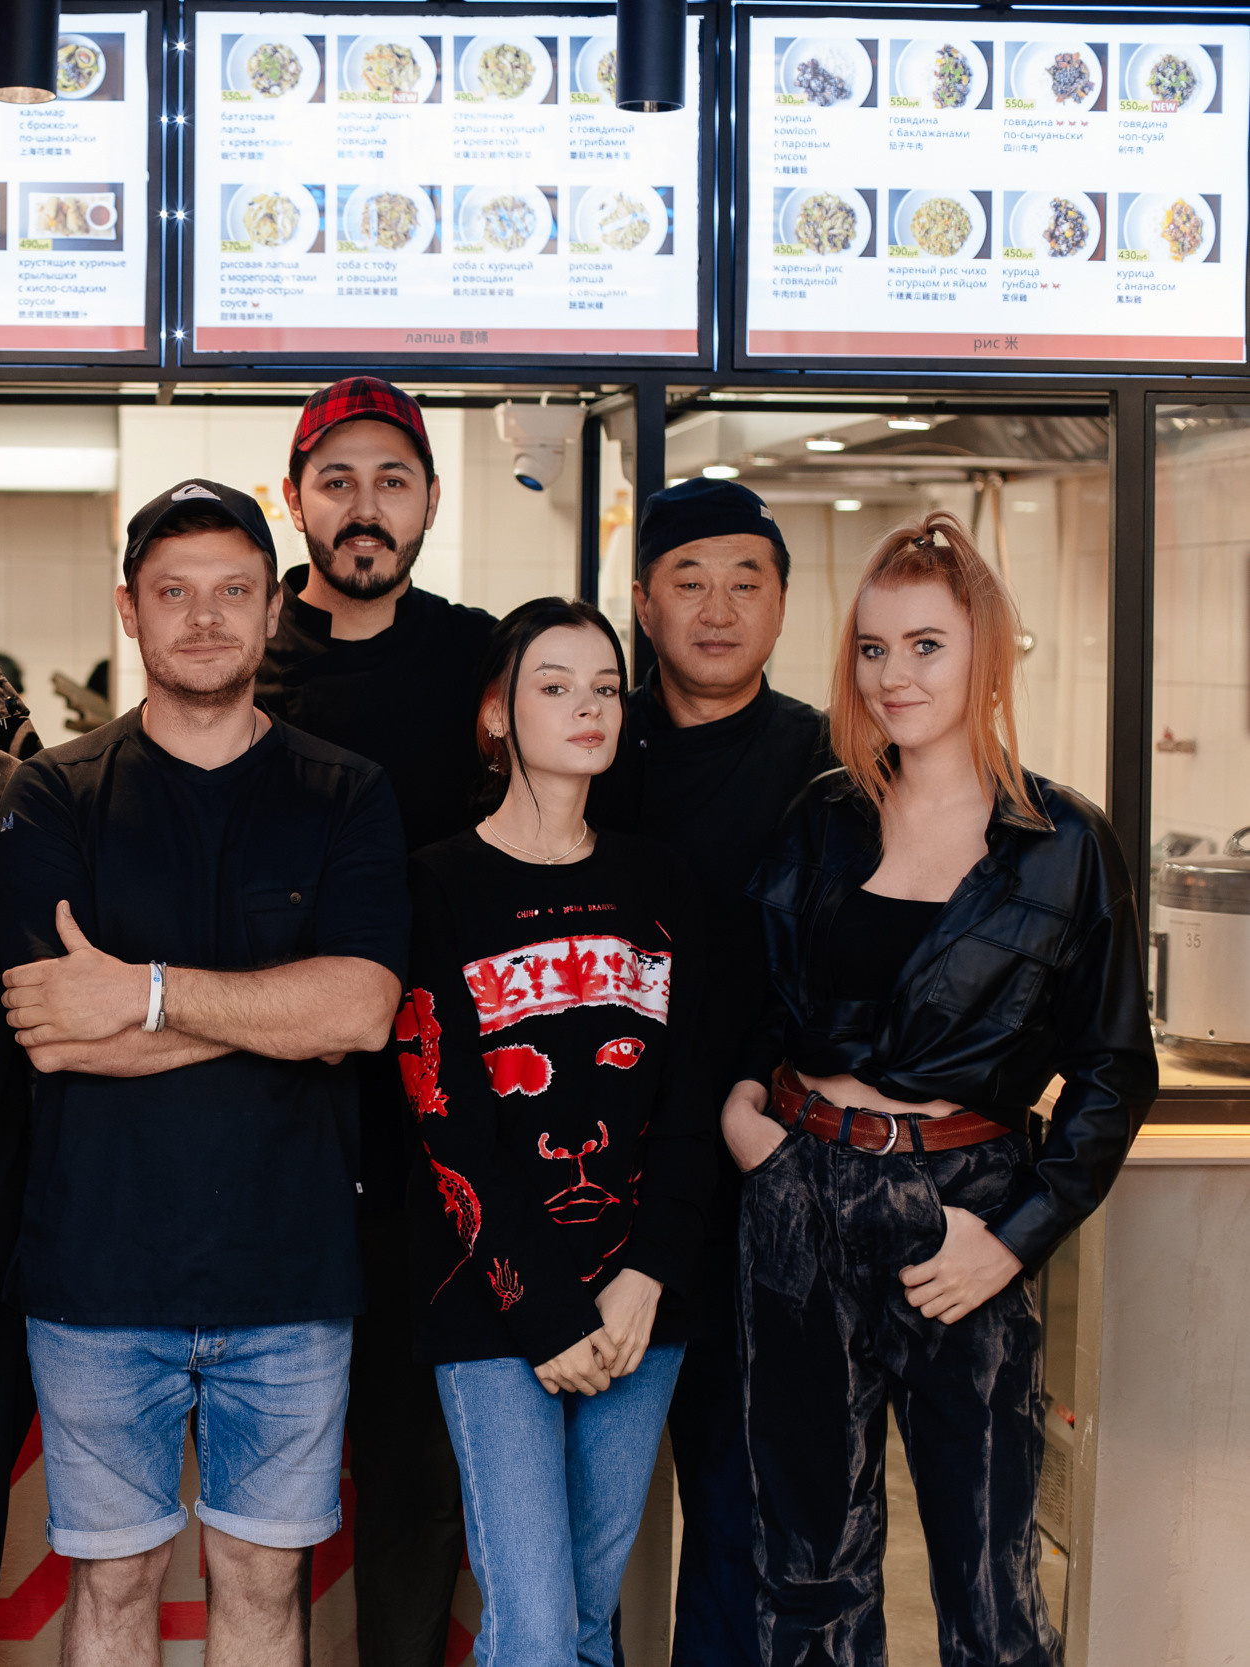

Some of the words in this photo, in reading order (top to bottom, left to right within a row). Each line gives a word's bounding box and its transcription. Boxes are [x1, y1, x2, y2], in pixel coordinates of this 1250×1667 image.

[1152, 102, 1177, 112] NEW
[774, 115, 812, 124] курица
[889, 116, 938, 125] говядина
[1004, 118, 1053, 128] говядина
[1118, 120, 1168, 129] говядина
[897, 128, 970, 138] баклажанами
[1003, 131, 1083, 142] по-сычуаньски
[825, 265, 843, 275] рис
[940, 267, 958, 277] рис
[1002, 269, 1040, 278] курица
[1117, 270, 1154, 280] курица
[780, 277, 837, 287] говядиной
[895, 280, 940, 289] огурцом
[952, 279, 987, 289] яйцом
[1002, 280, 1039, 291] гунбао
[1124, 283, 1176, 291] ананасом
[220, 300, 248, 310] соусе
[405, 333, 455, 343] лапша
[974, 339, 1000, 352] рис
[1004, 336, 1018, 350] 米
[516, 909, 539, 919] CHIHO
[1185, 932, 1202, 949] 35
